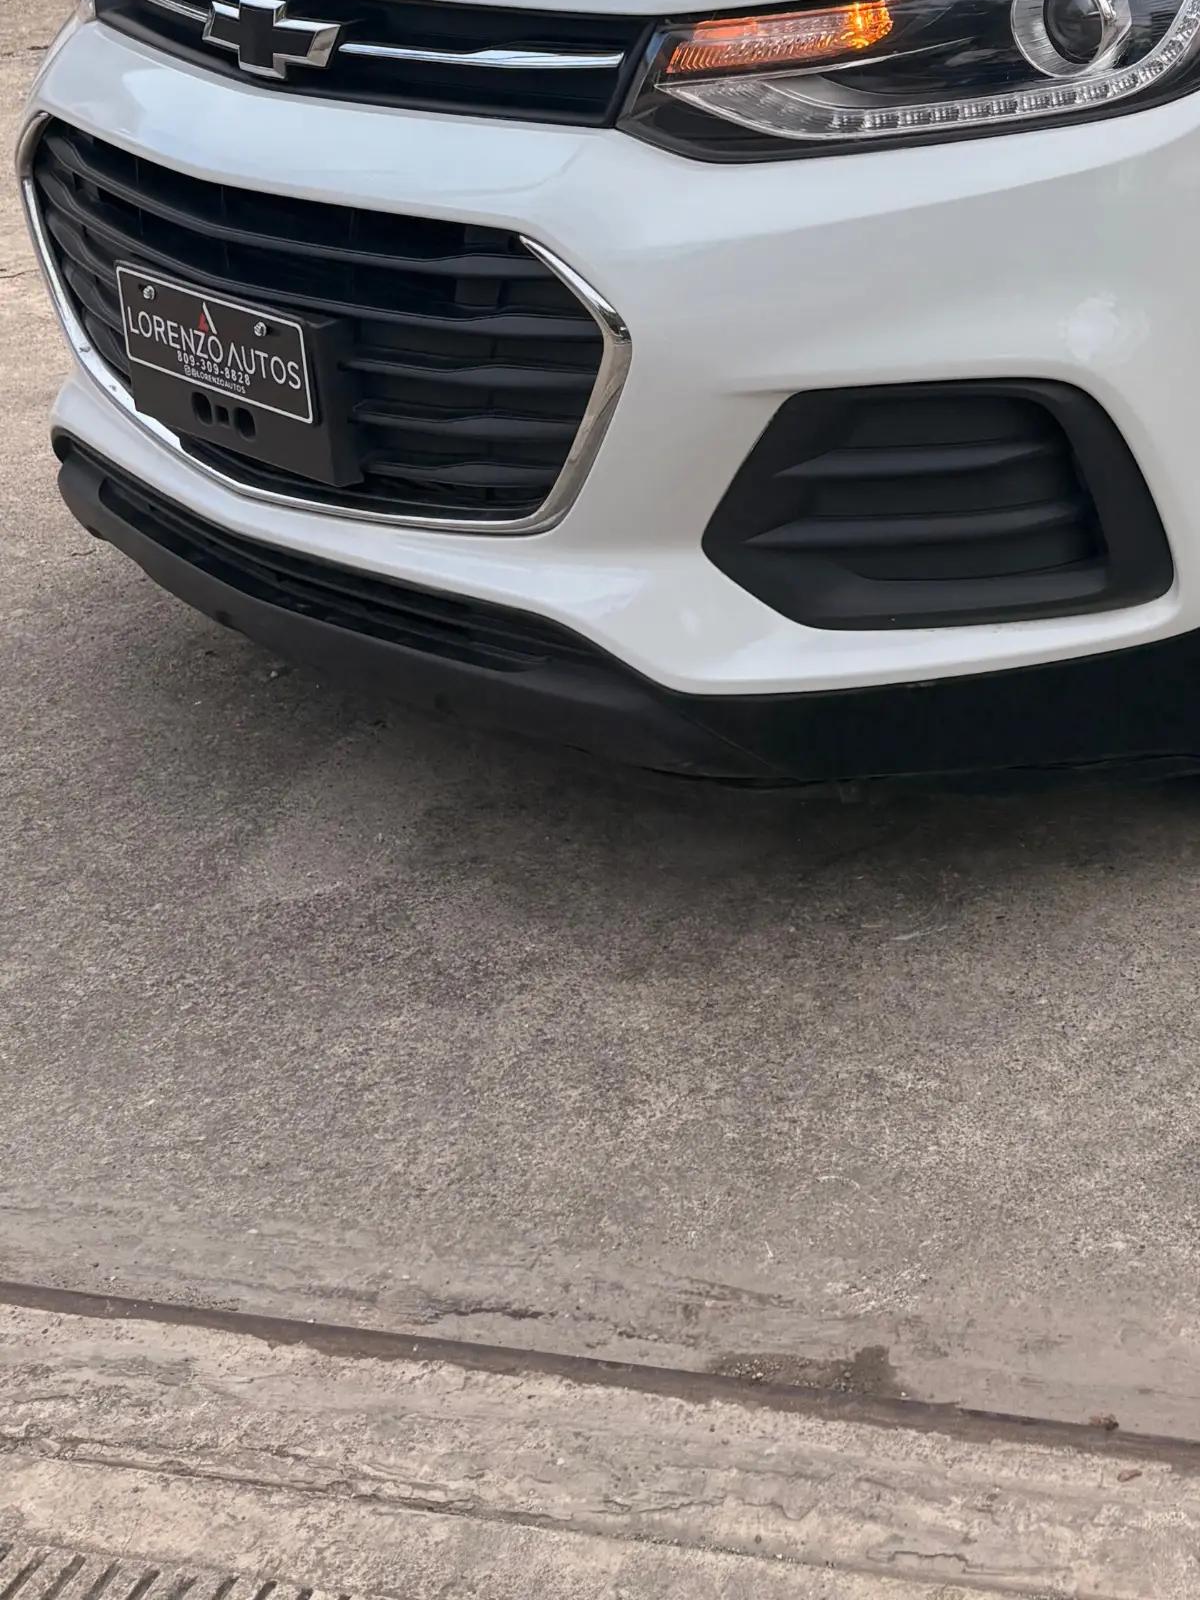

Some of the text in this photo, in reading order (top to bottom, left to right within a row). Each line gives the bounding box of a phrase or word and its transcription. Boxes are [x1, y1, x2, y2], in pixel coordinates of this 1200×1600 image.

[127, 305, 302, 390] LORENZO AUTOS
[177, 350, 251, 386] 809-309-8828
